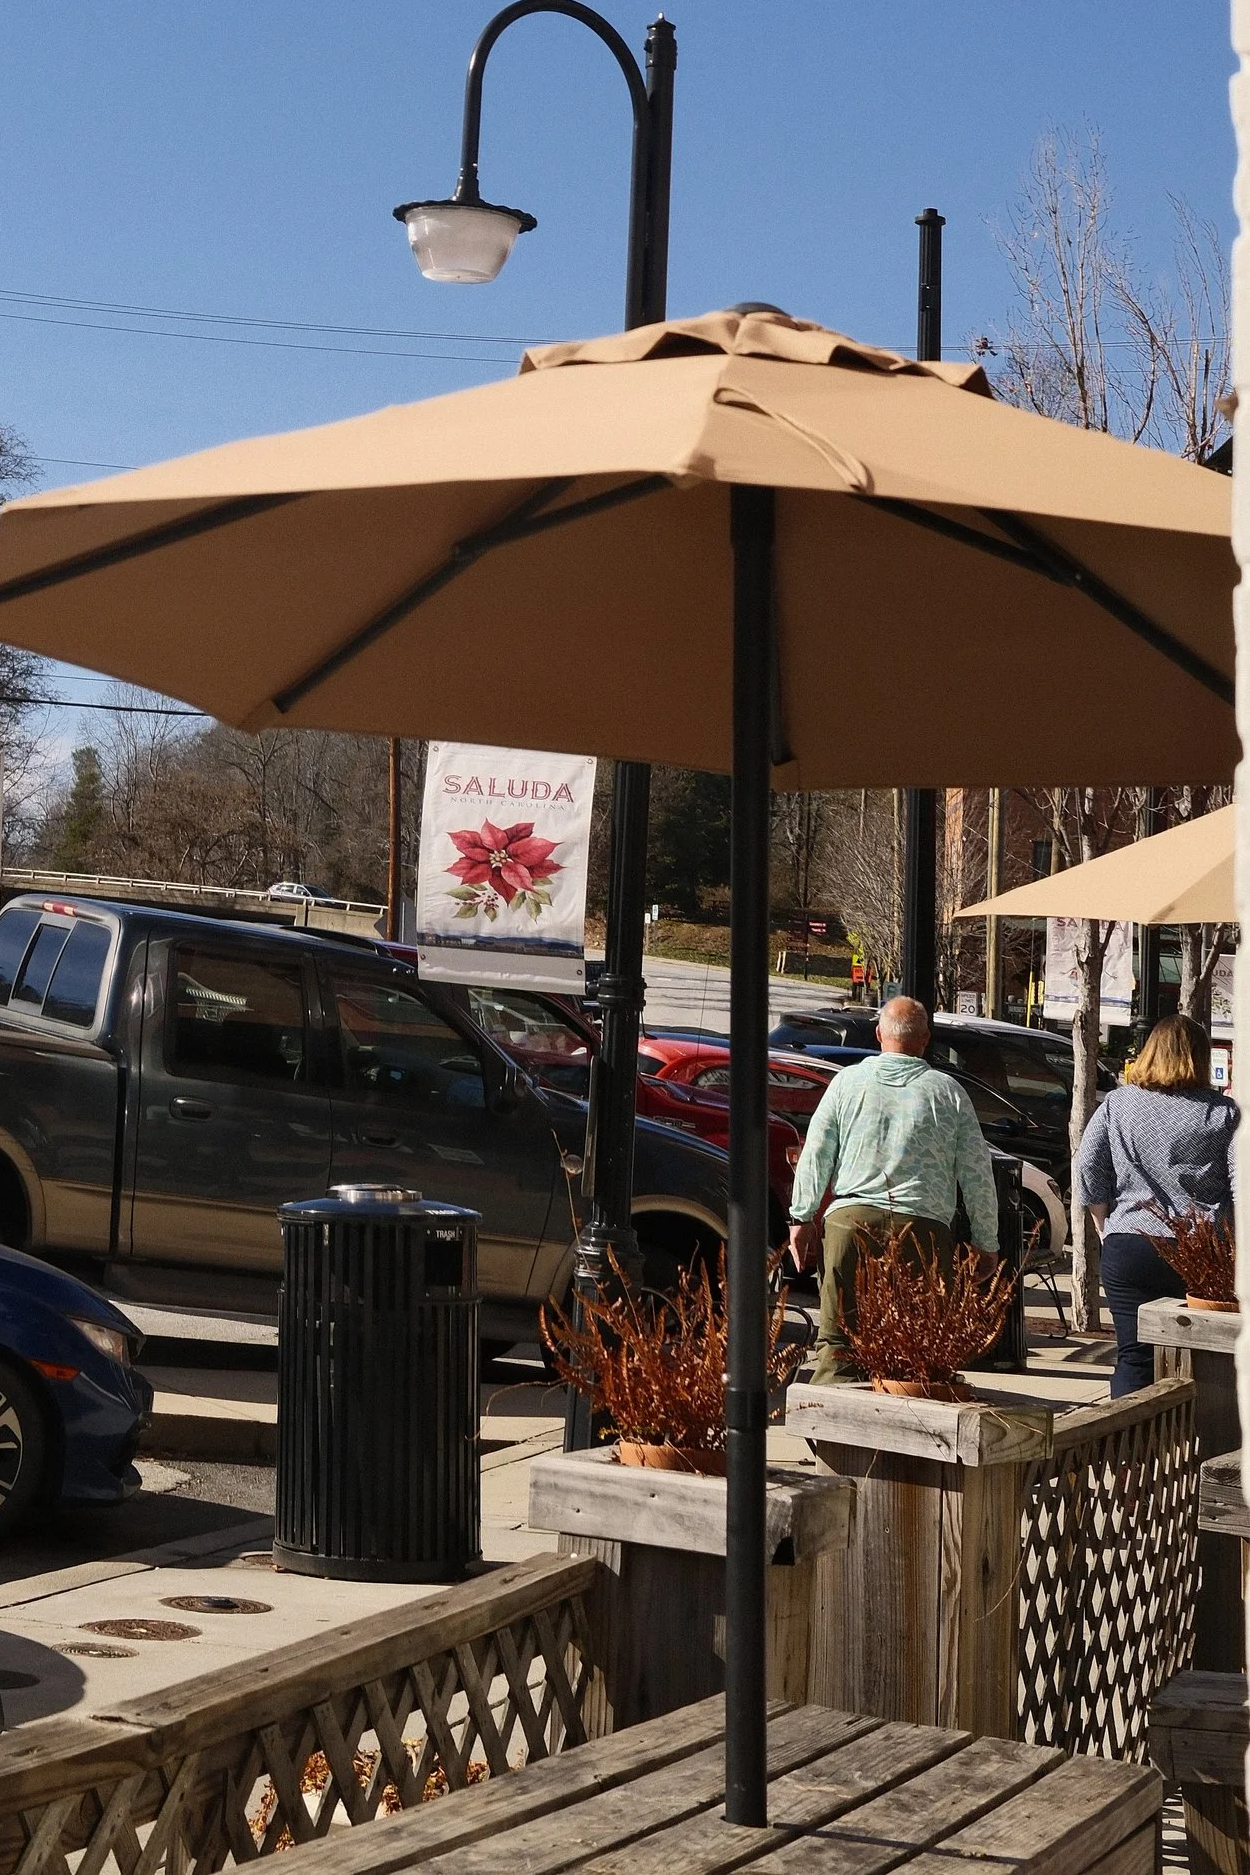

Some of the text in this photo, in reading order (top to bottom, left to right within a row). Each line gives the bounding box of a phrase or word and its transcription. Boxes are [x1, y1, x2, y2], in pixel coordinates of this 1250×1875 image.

[442, 774, 575, 804] SALUDA
[450, 796, 566, 812] NORTH CAROLINA
[960, 1004, 976, 1014] 20
[435, 1229, 456, 1239] TRASH
